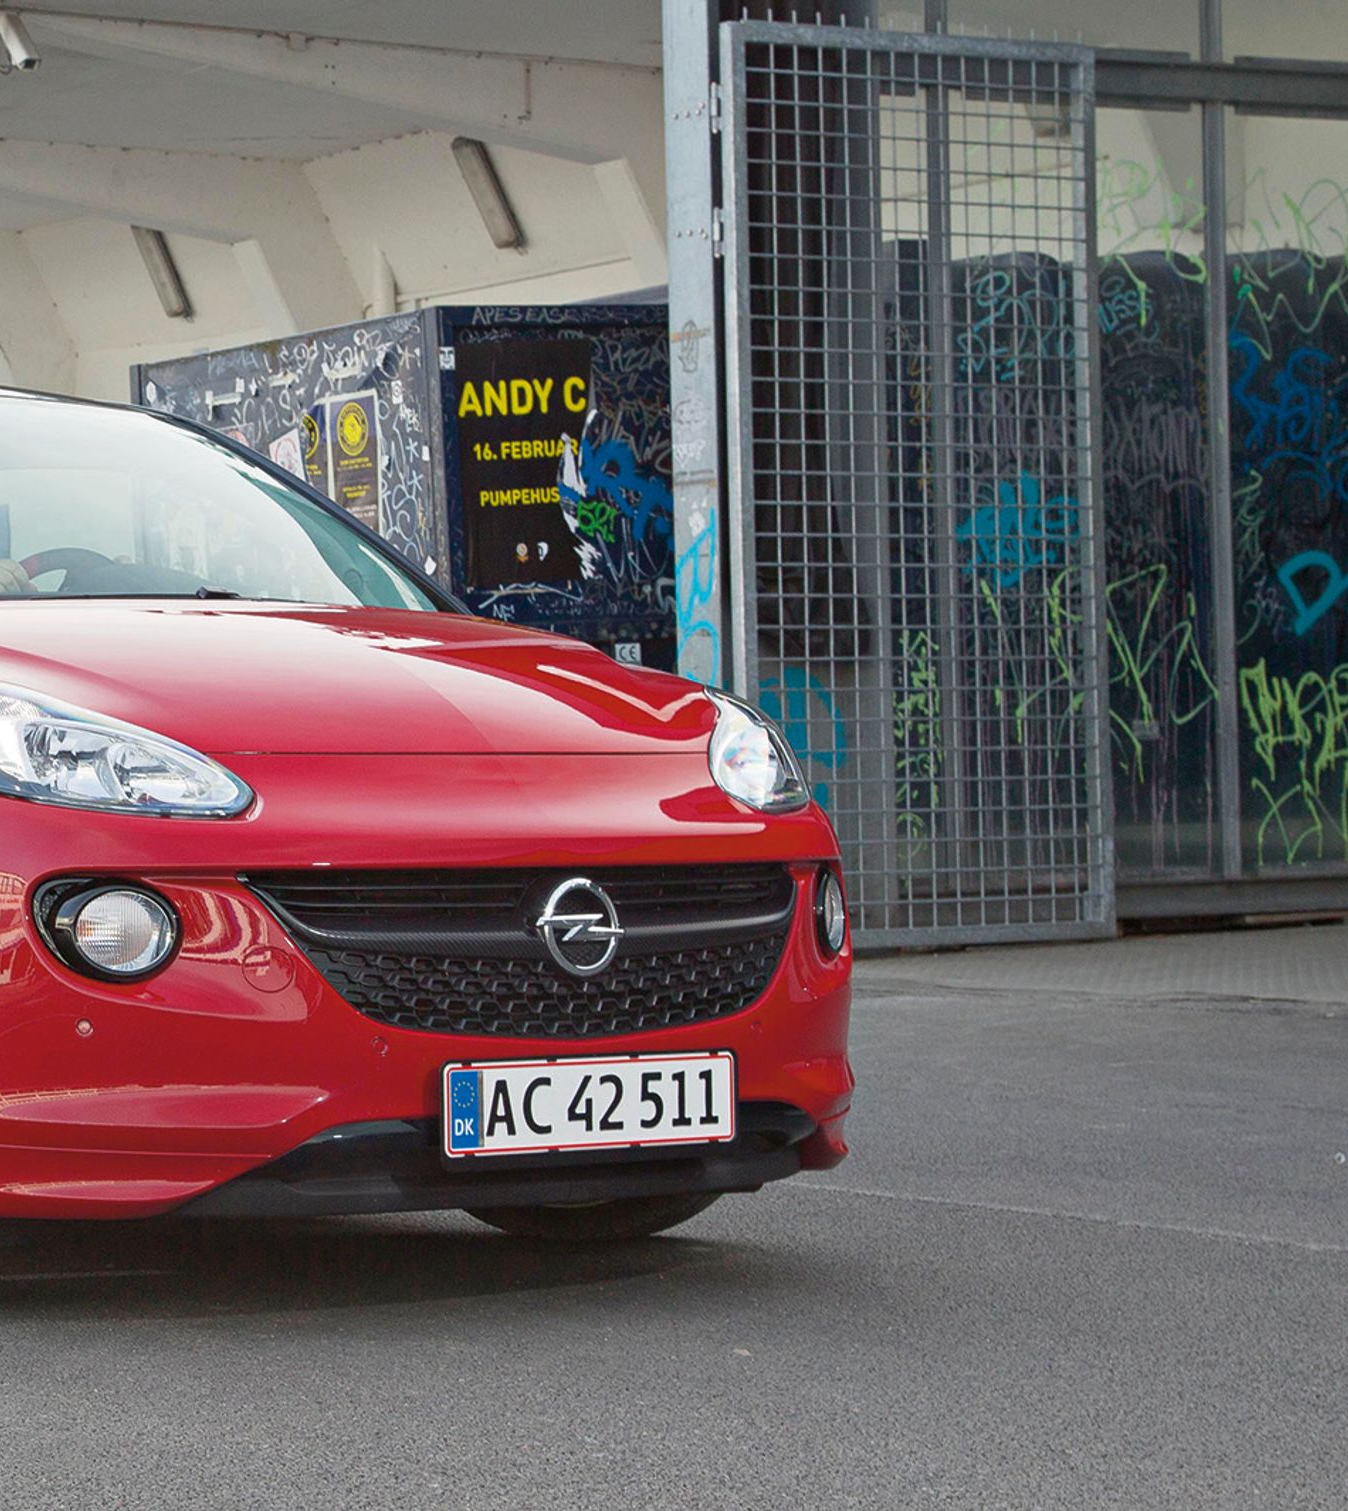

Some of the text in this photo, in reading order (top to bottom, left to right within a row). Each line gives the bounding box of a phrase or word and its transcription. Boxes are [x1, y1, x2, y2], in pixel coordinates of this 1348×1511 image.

[458, 377, 553, 417] ANDY
[563, 376, 587, 413] C
[473, 443, 497, 460] 16.
[486, 1068, 719, 1137] AC 42 511
[454, 1118, 475, 1137] DK
